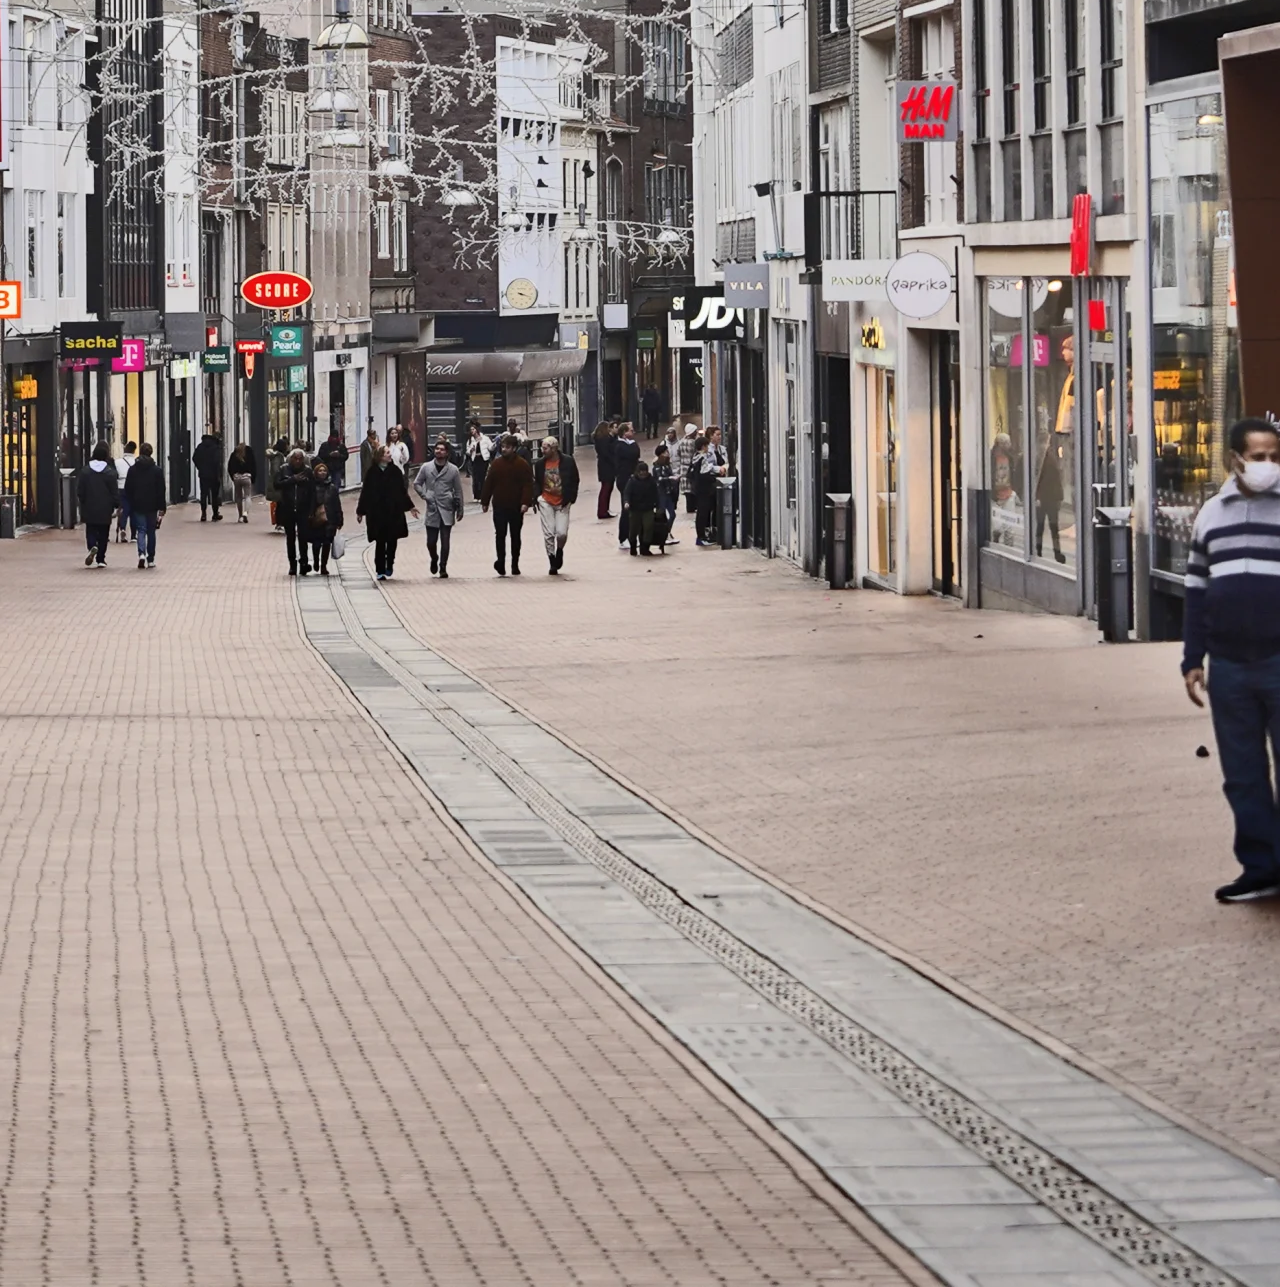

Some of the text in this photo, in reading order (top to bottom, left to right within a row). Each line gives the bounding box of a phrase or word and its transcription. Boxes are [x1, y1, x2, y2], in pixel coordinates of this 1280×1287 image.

[901, 85, 954, 122] H&M
[904, 123, 945, 139] MAN
[255, 283, 299, 297] SCORE
[729, 282, 763, 290] VILA
[892, 278, 947, 293] paprika
[689, 297, 735, 329] JD
[65, 335, 117, 348] sacha
[273, 340, 301, 349] Pearle
